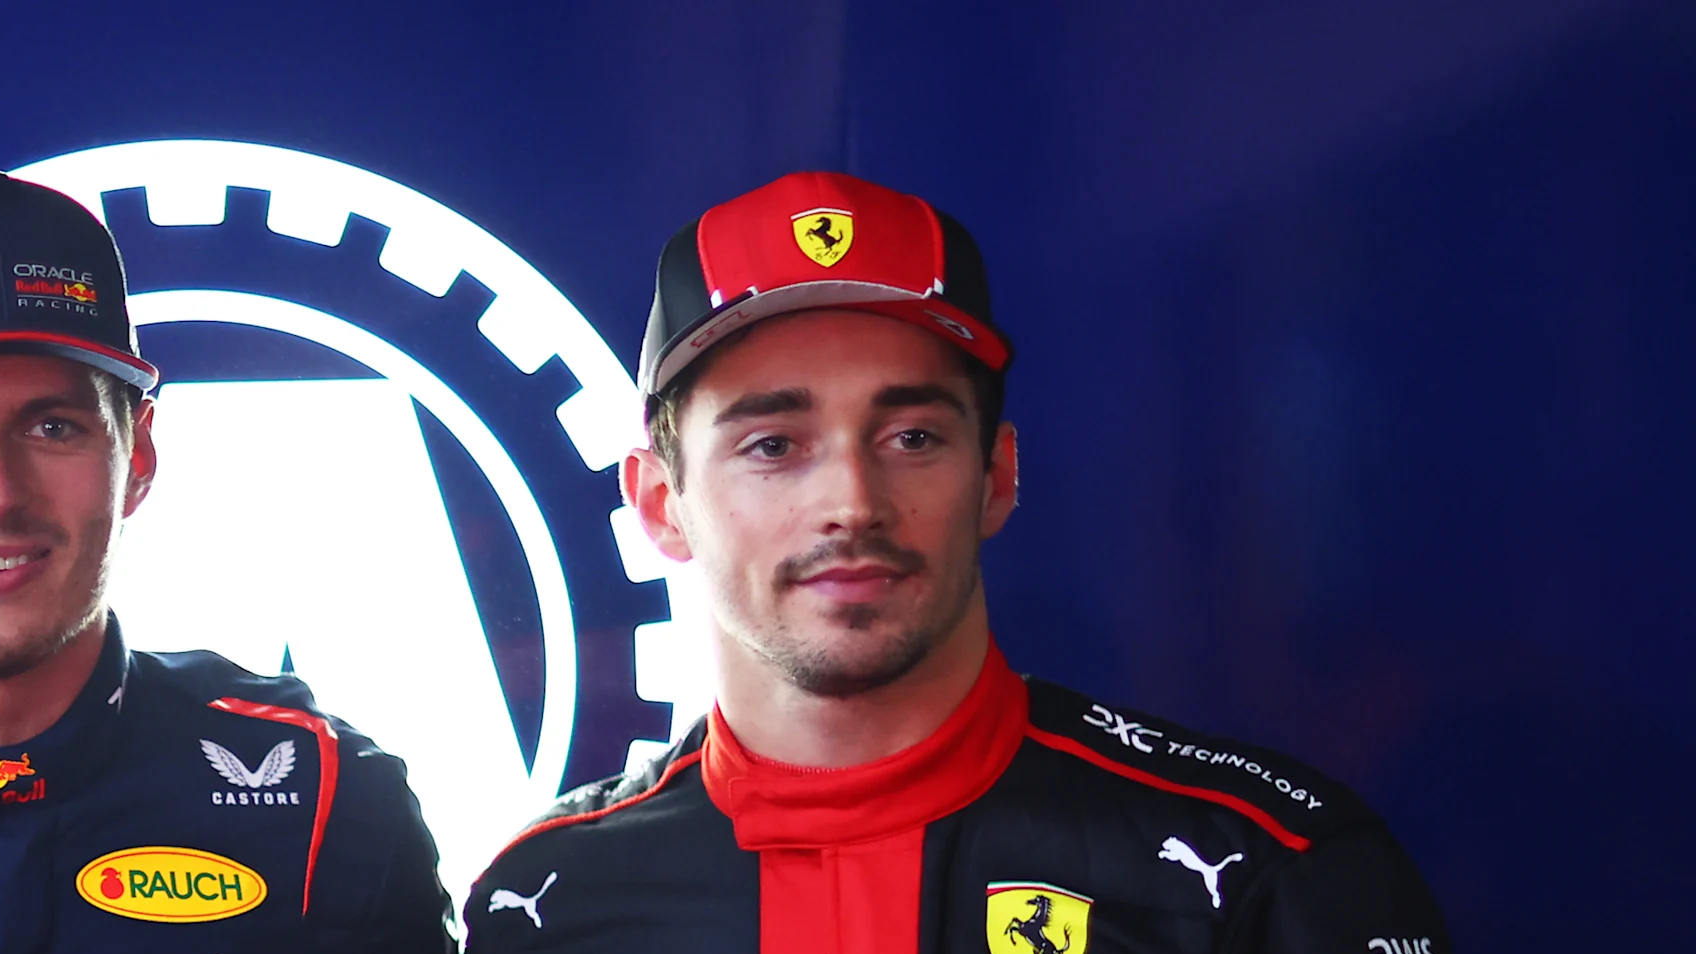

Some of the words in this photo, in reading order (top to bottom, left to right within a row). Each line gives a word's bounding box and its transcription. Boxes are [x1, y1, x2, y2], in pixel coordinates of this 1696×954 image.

[14, 263, 94, 285] ORACLE
[18, 298, 98, 316] RACING
[1083, 704, 1163, 753] DXC
[1167, 741, 1322, 810] TECHNOLOGY
[212, 791, 300, 806] CASTORE
[129, 869, 243, 901] RAUCH
